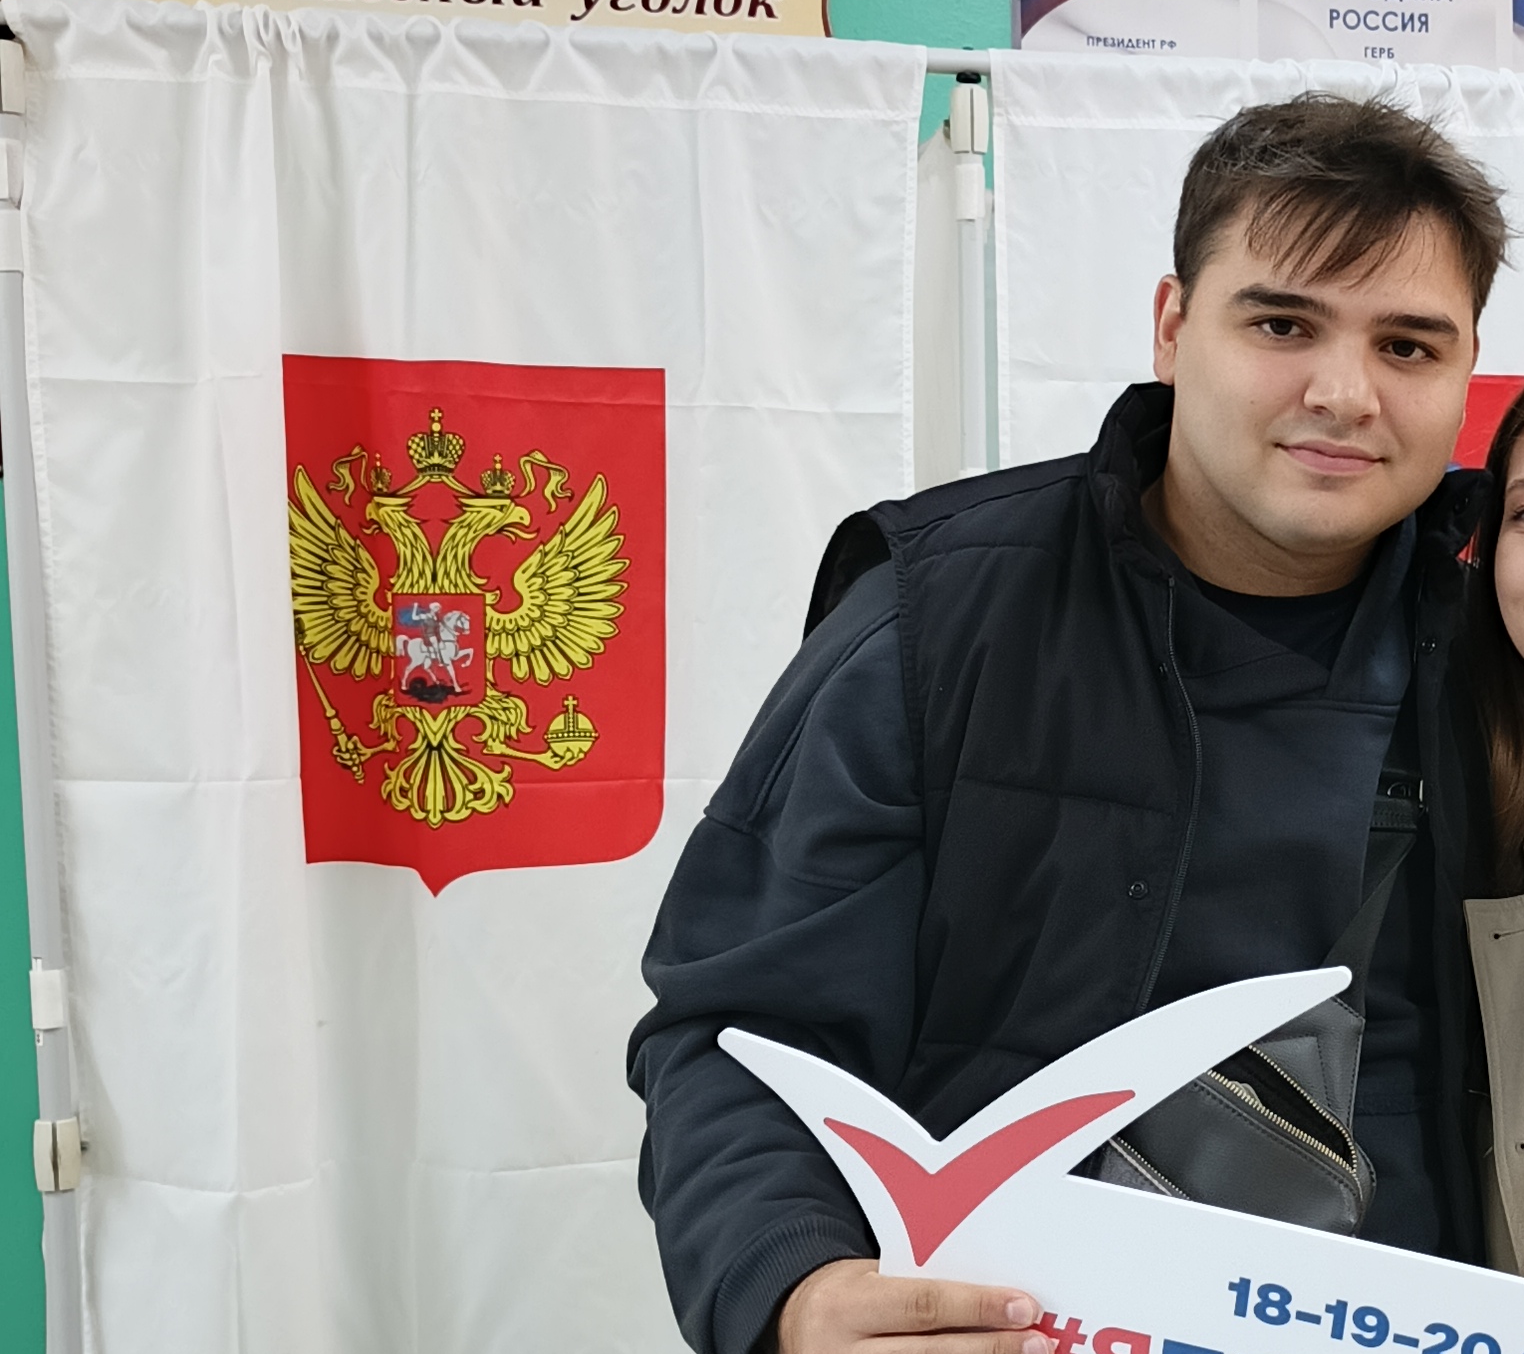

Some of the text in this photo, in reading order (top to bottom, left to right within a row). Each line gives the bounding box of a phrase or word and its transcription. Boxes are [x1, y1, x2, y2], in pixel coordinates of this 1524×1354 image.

[1329, 8, 1431, 34] РОССИЯ
[1086, 35, 1178, 50] ПРЕЗИДЕНТ РФ
[1364, 46, 1395, 60] ГЕРБ
